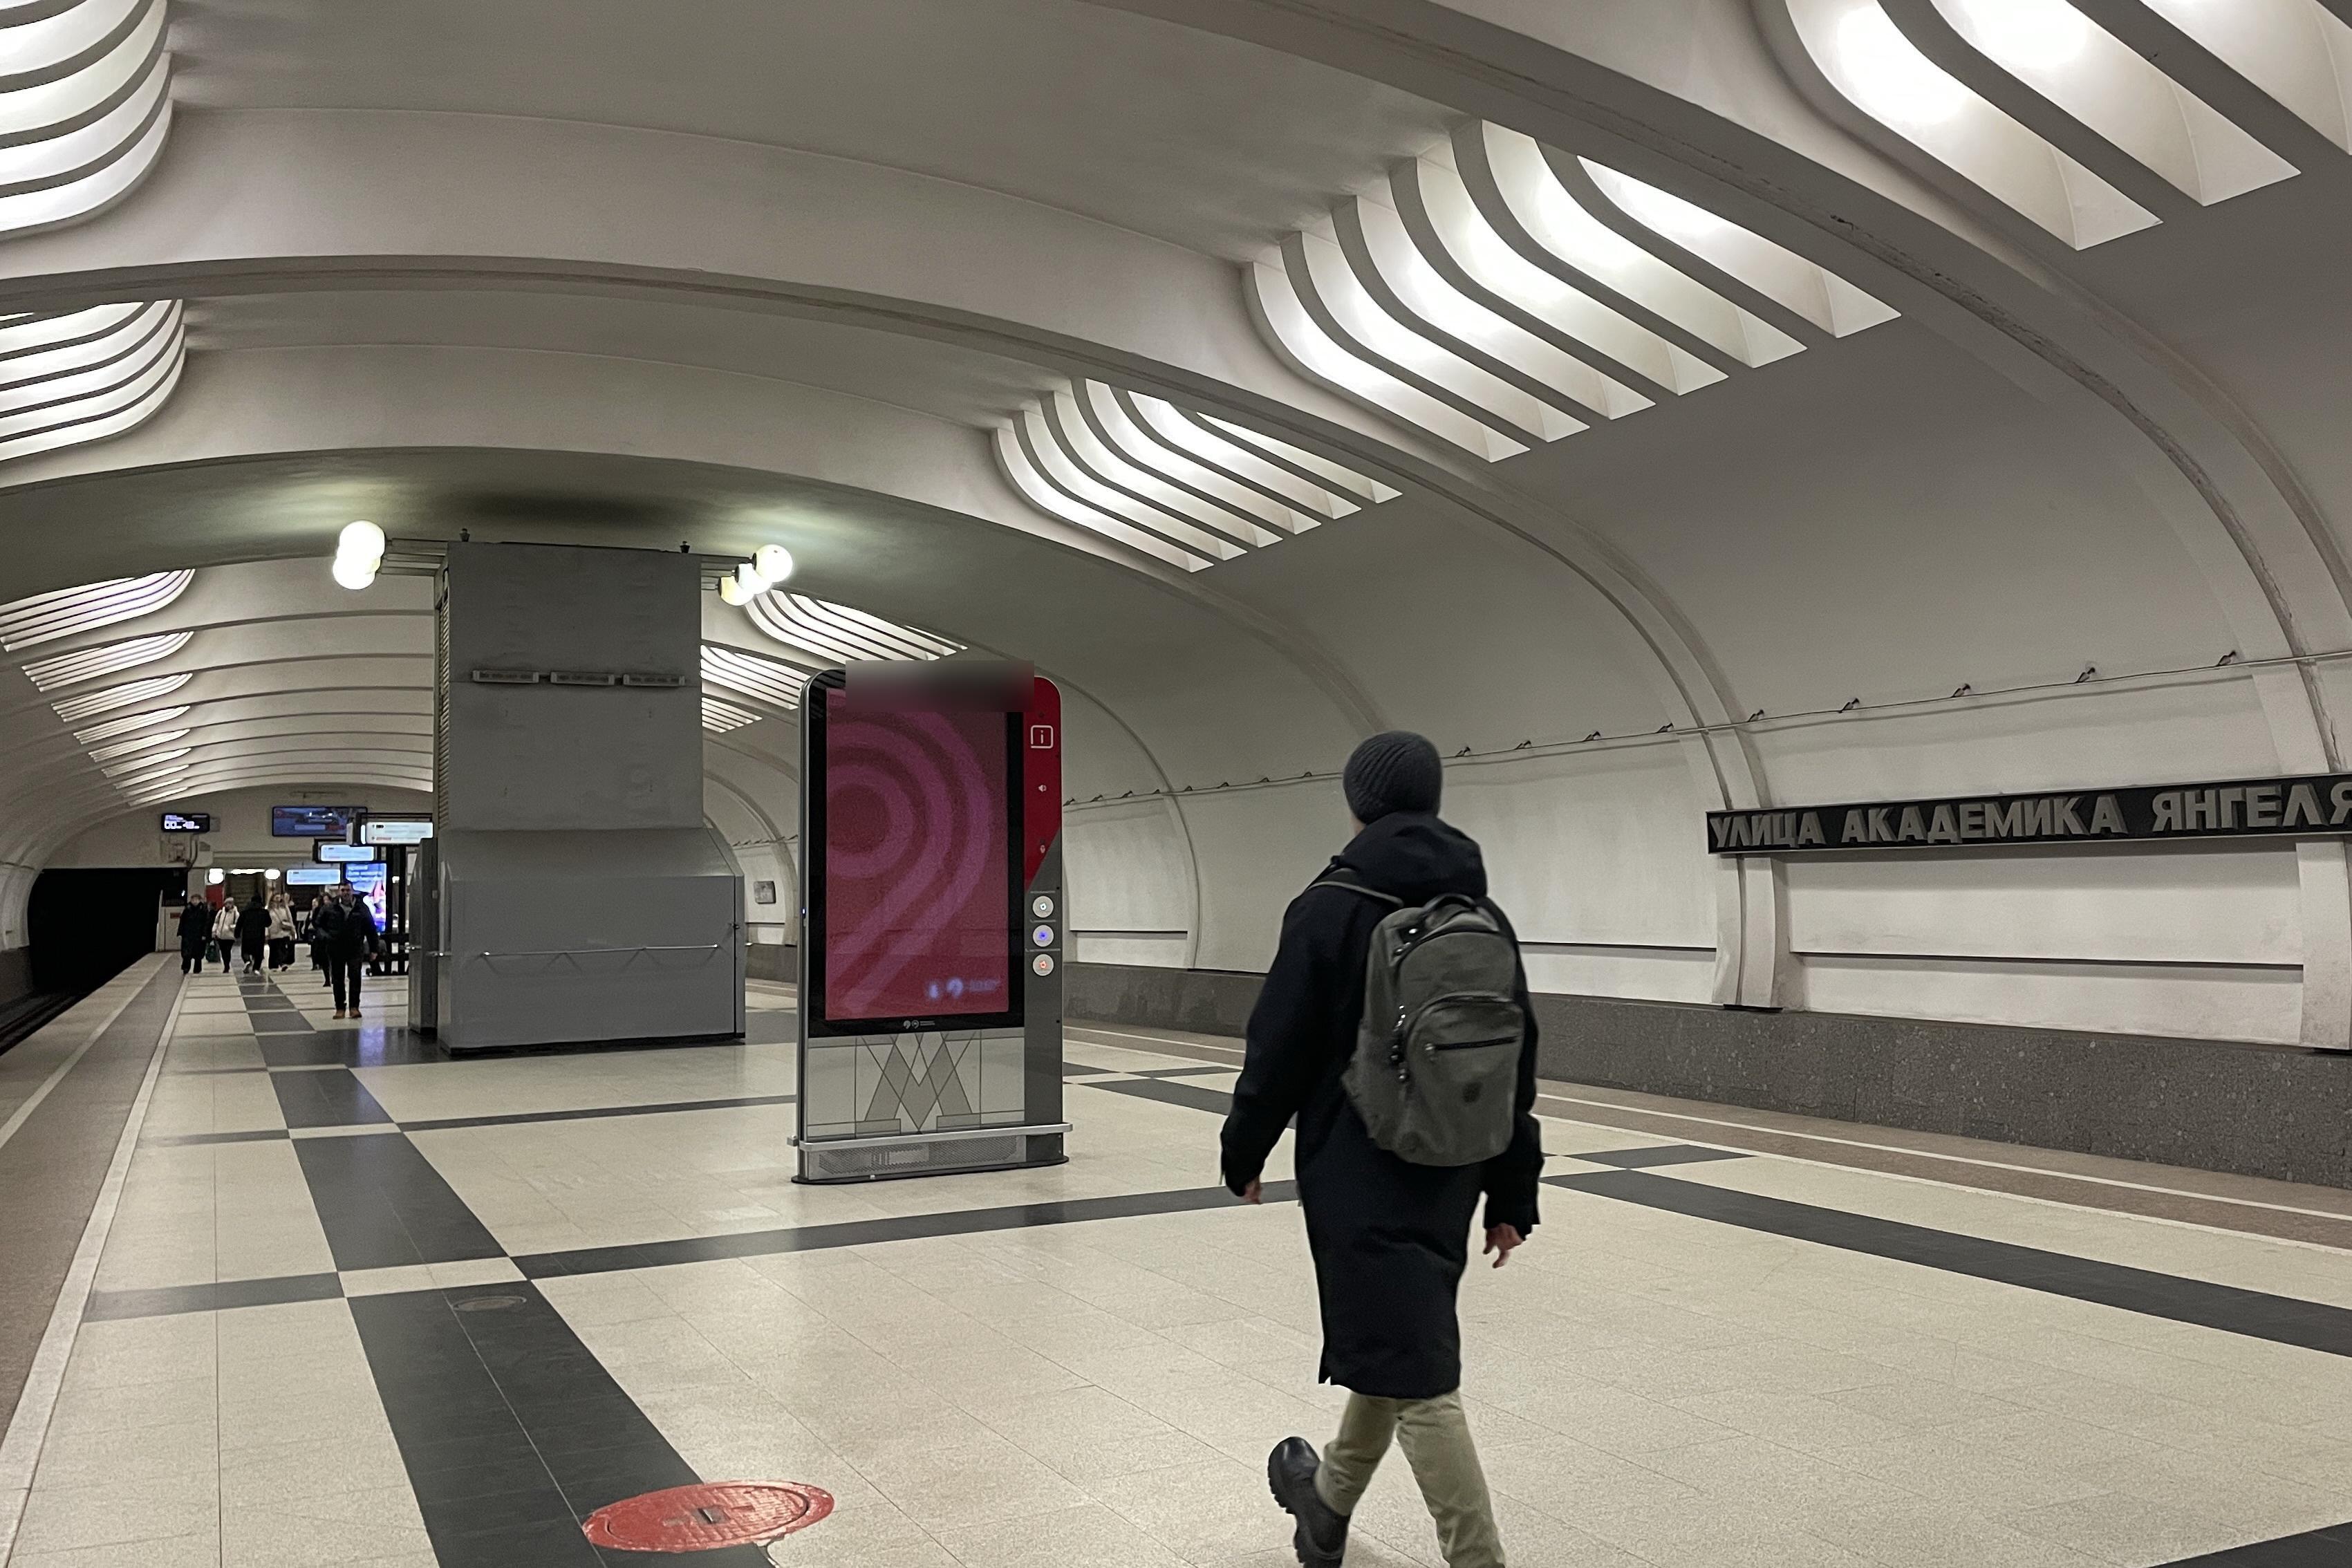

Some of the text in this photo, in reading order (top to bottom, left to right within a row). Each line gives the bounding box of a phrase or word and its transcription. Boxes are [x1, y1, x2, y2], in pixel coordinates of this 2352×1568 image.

[1709, 781, 2352, 848] УЛИЦА АКАДЕМИКА ЯНГЕЛЯ
